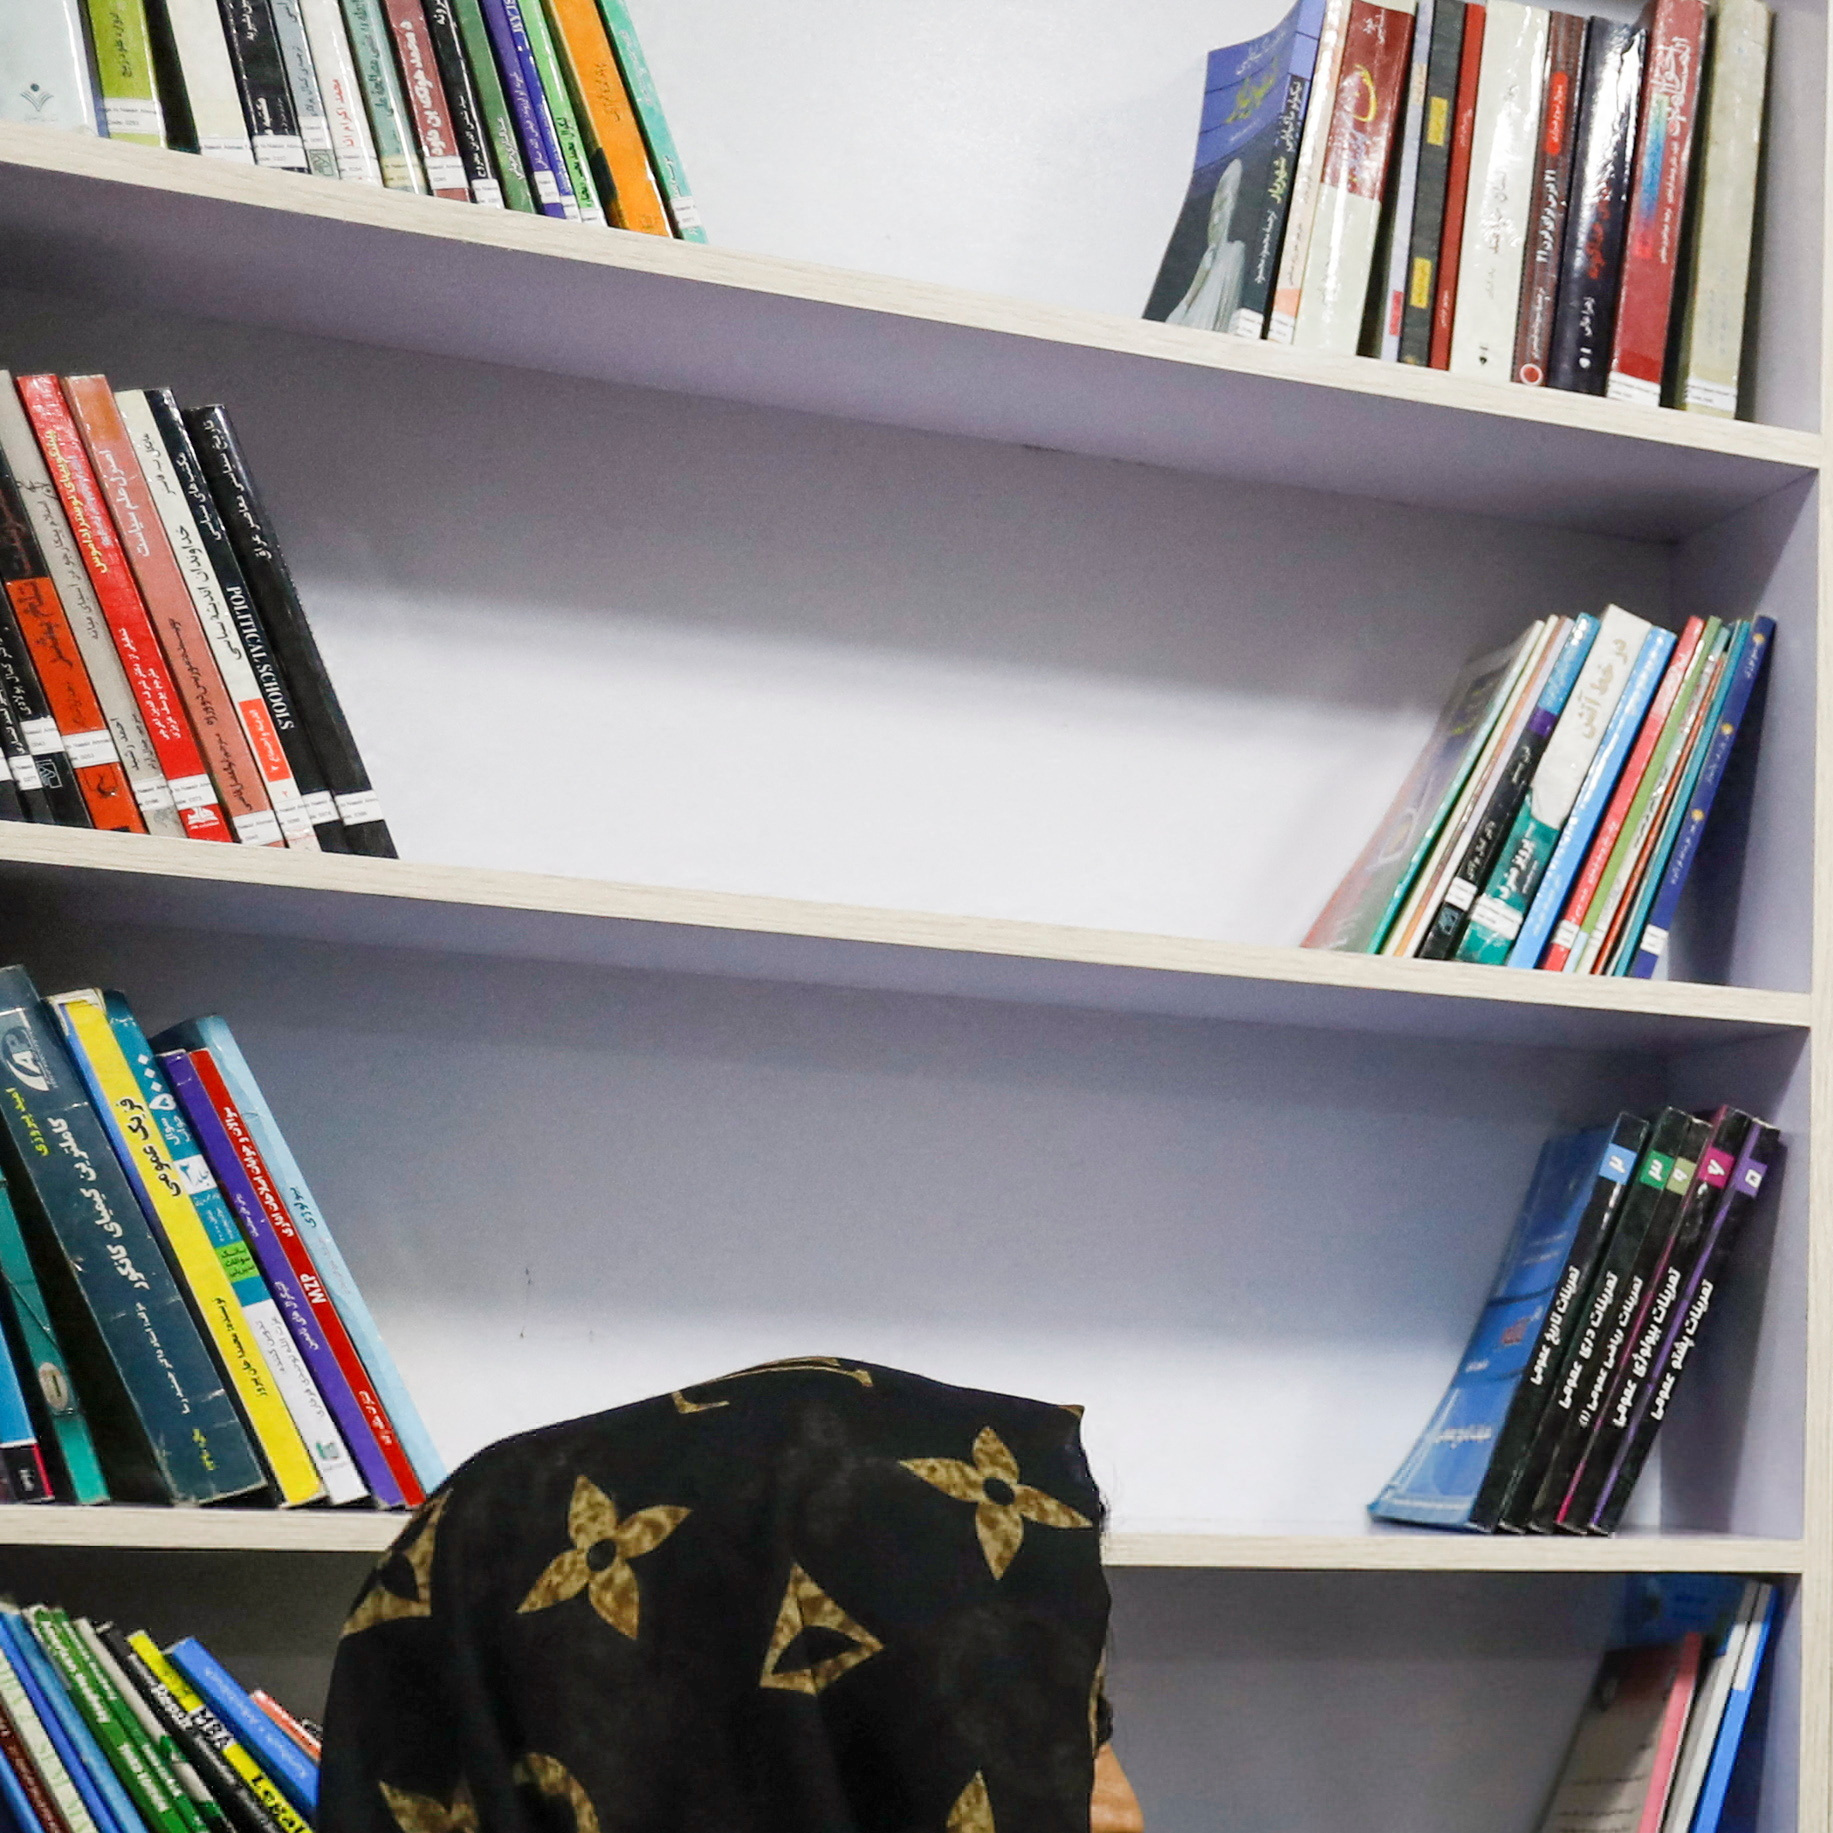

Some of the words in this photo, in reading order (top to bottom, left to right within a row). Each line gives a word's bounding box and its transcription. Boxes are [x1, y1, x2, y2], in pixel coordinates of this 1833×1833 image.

[203, 418, 227, 452] تاریخ
[215, 452, 244, 495] سیاسی
[233, 493, 260, 533] معاصر
[250, 531, 274, 562] عراق
[224, 584, 267, 665] POLITICAL
[256, 663, 294, 732] SCHOOLS
[114, 1093, 155, 1144] فزیک
[140, 1141, 184, 1199] عمومی
[44, 1111, 97, 1186] کاملترین
[79, 1182, 123, 1241] کیمیای
[107, 1239, 148, 1295] کانکور
[304, 1279, 325, 1307] MZP
[1554, 1267, 1582, 1314] تمرینات
[1588, 1272, 1620, 1328] تمرینات
[1650, 1267, 1682, 1323] تمرینات
[1544, 1312, 1567, 1343] تاریخ
[1577, 1328, 1599, 1359] دری
[1628, 1323, 1661, 1378] بیولوژی
[1528, 1344, 1553, 1385] عمومی
[1557, 1361, 1586, 1409] عمومی
[1610, 1379, 1639, 1427] عمومی
